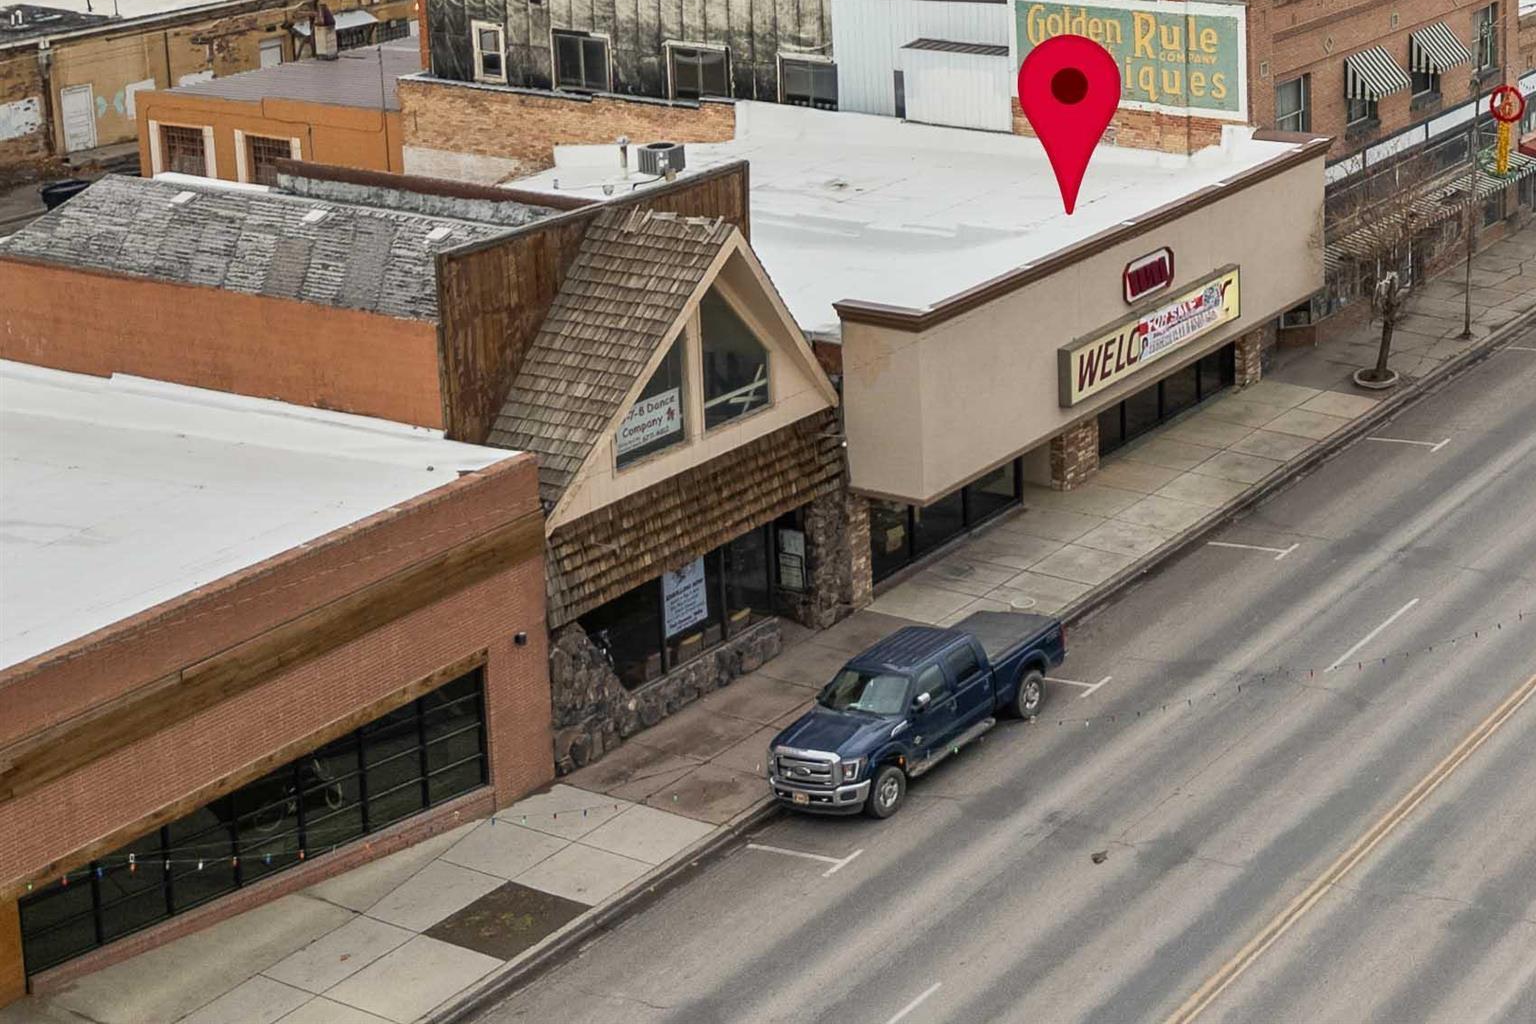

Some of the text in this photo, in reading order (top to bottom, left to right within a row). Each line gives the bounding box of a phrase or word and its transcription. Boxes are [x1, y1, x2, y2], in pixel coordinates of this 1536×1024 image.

[1026, 3, 1123, 46] Golden
[1131, 9, 1219, 59] Rule
[1158, 51, 1218, 65] COMPANY
[1123, 56, 1227, 102] iques
[1078, 326, 1141, 393] WELC
[647, 395, 675, 413] Dance
[622, 416, 664, 438] Company
